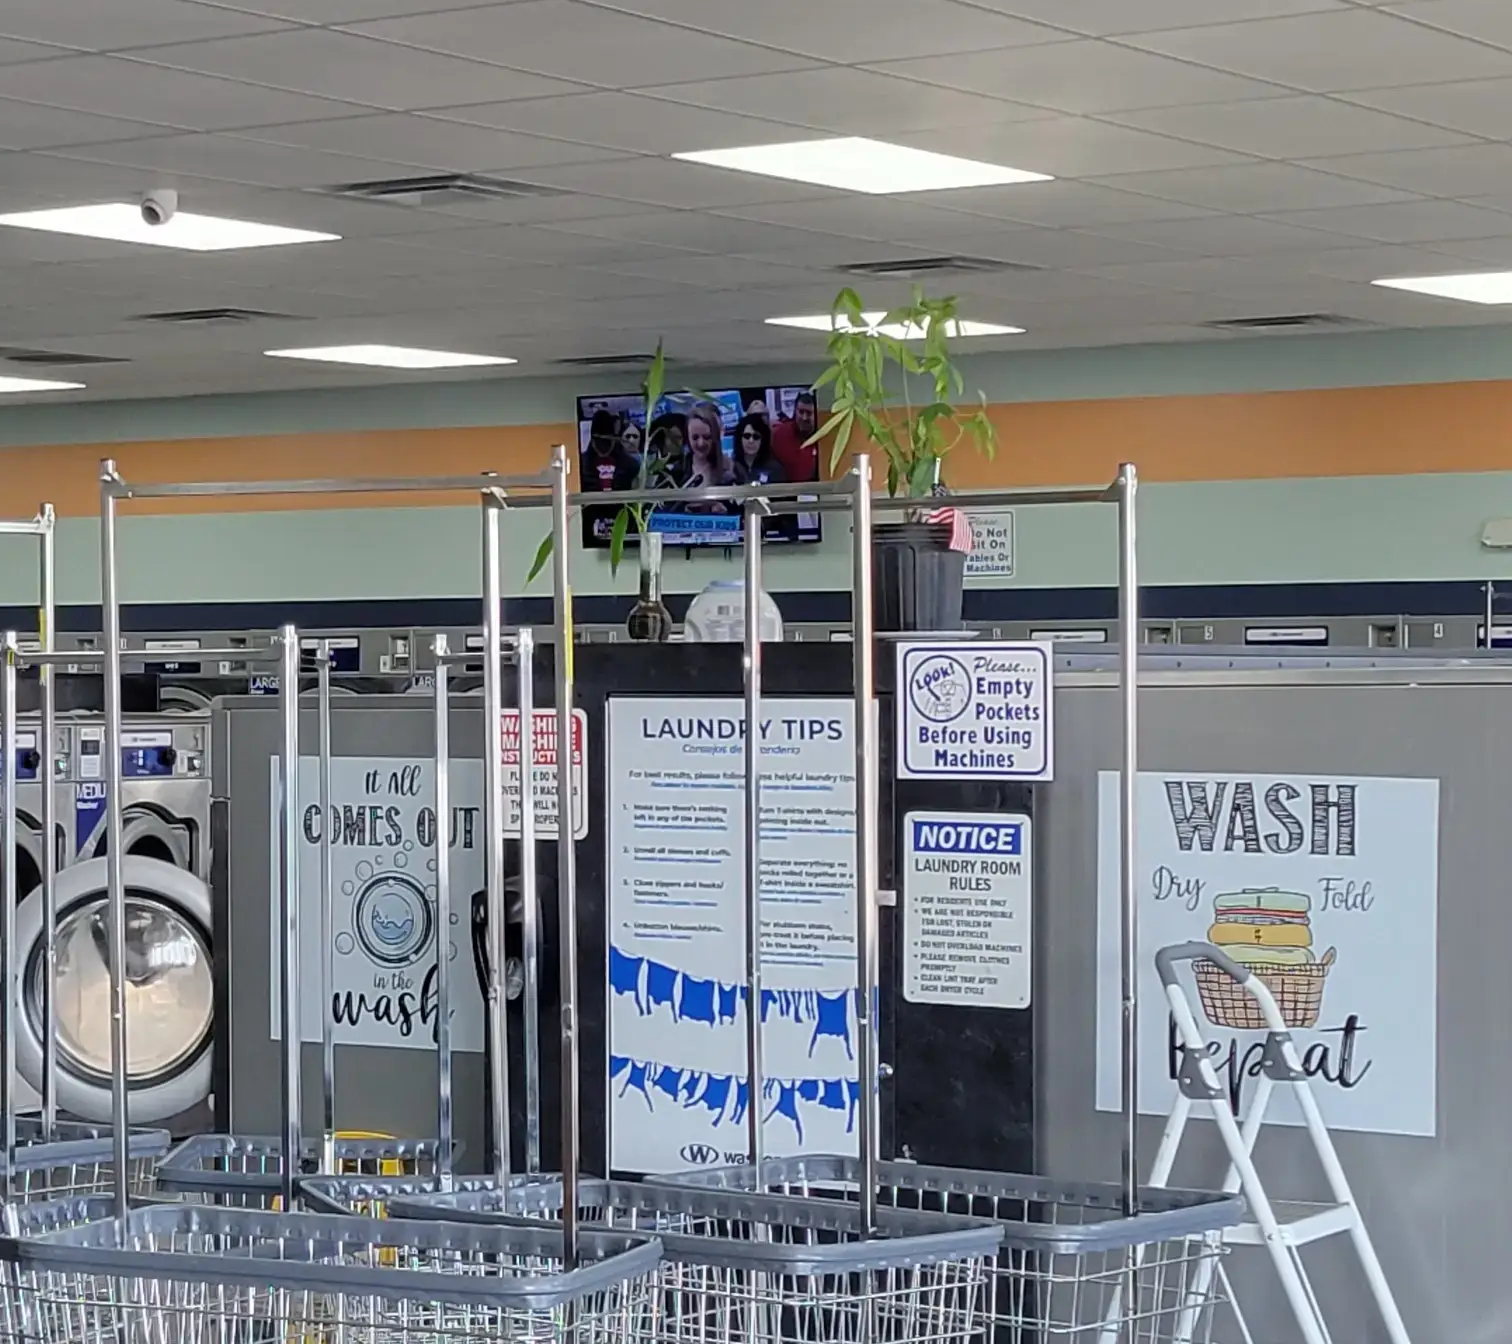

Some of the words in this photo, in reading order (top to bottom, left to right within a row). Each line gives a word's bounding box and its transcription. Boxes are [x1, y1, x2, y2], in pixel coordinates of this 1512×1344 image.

[652, 518, 692, 530] PROTECT
[987, 528, 1007, 537] Not
[990, 539, 1005, 549] On
[998, 552, 1009, 562] Or
[966, 564, 1011, 573] Machines
[976, 677, 1033, 698] Empty
[975, 703, 1040, 720] Pockets
[643, 718, 772, 740] LAUNDRY
[781, 719, 843, 740] TIPS
[919, 726, 977, 744] Before
[984, 726, 1032, 749] Using
[934, 749, 1014, 768] Machines
[774, 772, 803, 782] helpful
[806, 772, 838, 783] laundry
[77, 783, 106, 800] MEDIU
[303, 804, 402, 846] COMES
[1164, 781, 1358, 856] WASH
[919, 825, 1015, 851] NOTICE
[915, 859, 977, 874] LAUNDRY
[981, 861, 1021, 875] ROOM
[949, 877, 992, 891] RULES
[1153, 866, 1206, 912] Dry
[1318, 877, 1375, 912] Fold
[921, 896, 934, 904] FOR
[921, 907, 932, 915] WE
[935, 908, 948, 916] ARE
[921, 940, 931, 948] DO
[921, 953, 946, 961] PLEASE
[373, 973, 389, 990] in
[391, 970, 414, 991] the
[332, 962, 456, 1044] wash
